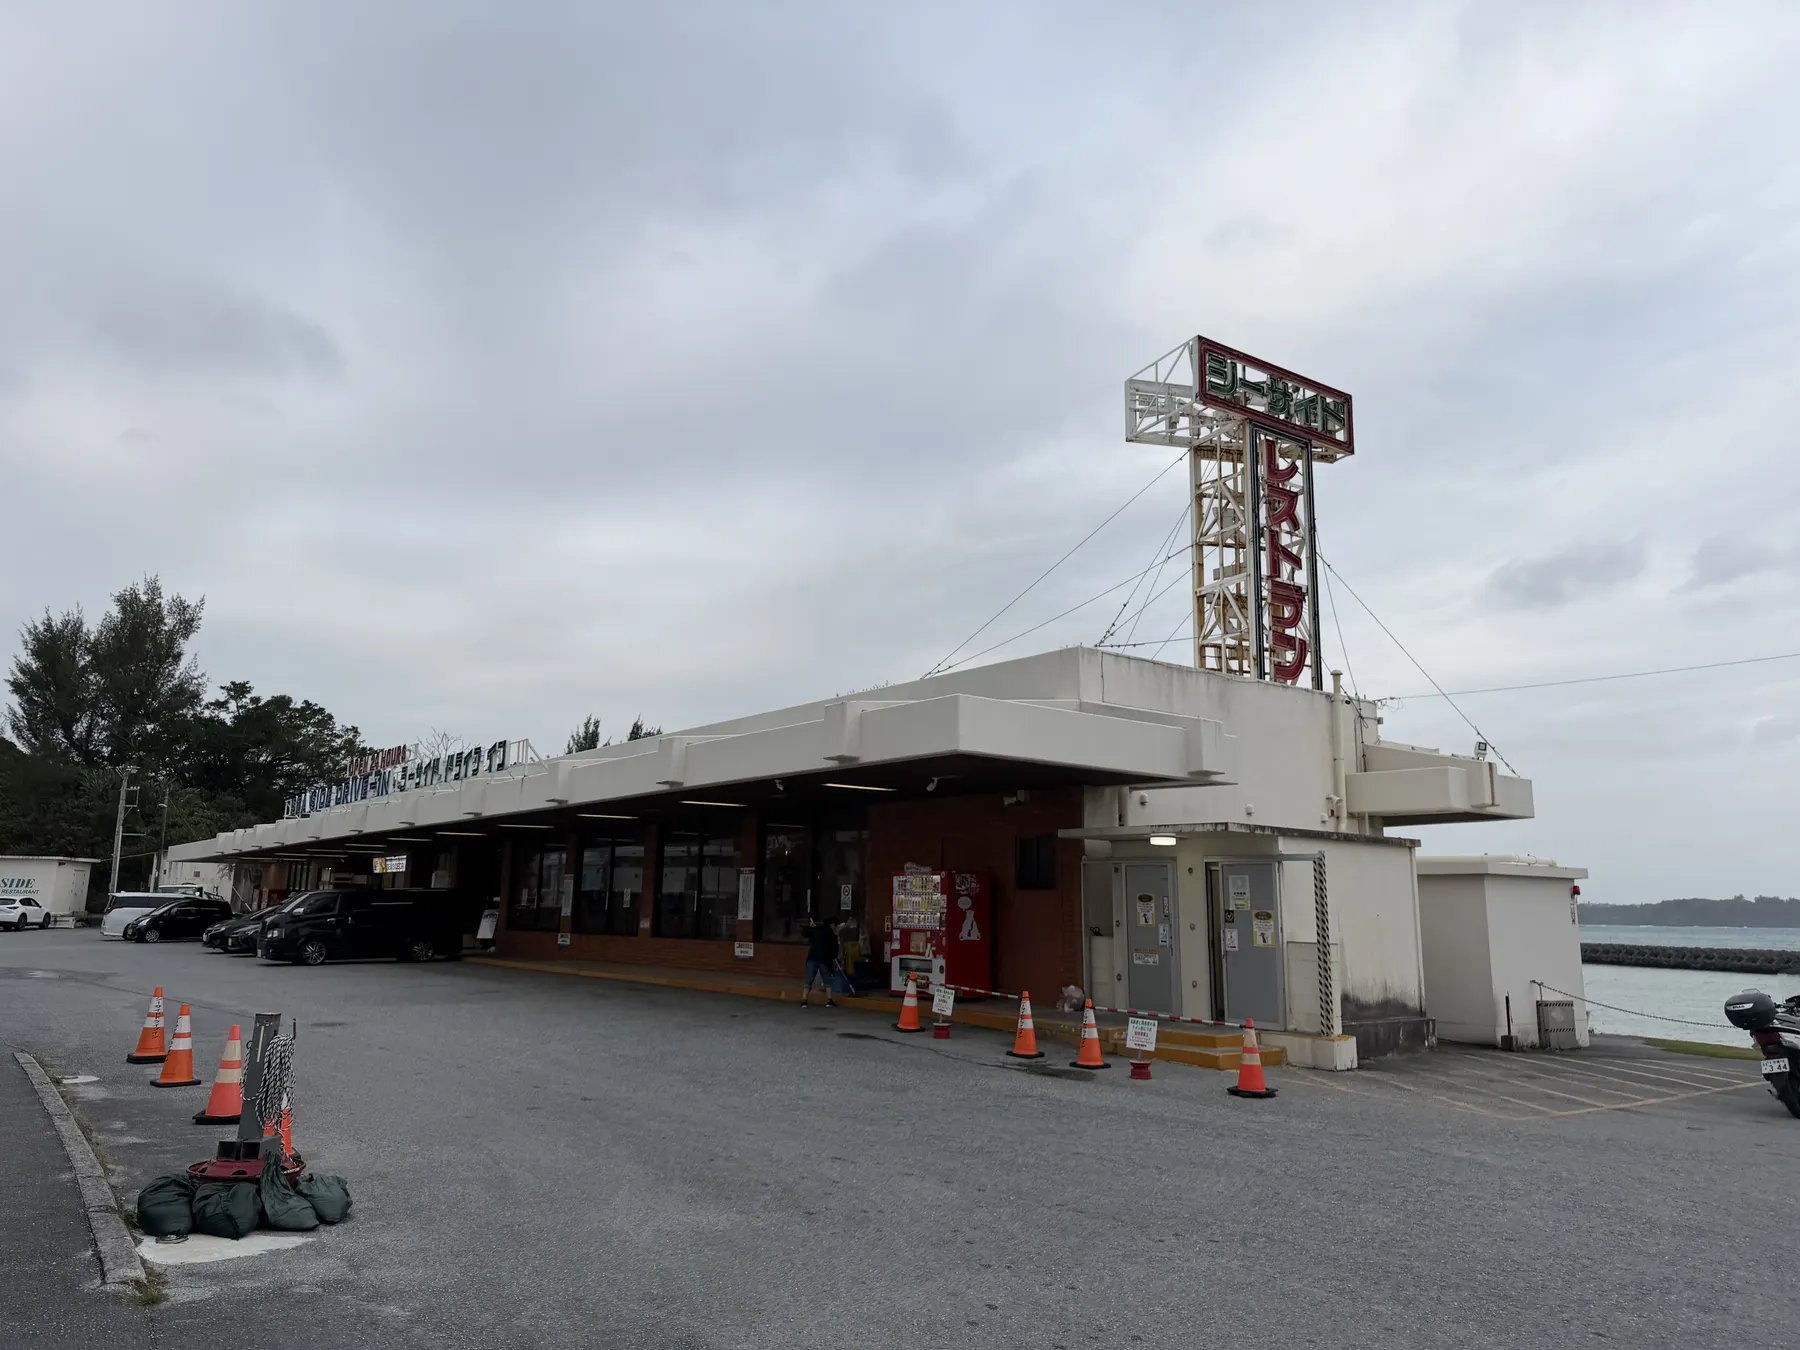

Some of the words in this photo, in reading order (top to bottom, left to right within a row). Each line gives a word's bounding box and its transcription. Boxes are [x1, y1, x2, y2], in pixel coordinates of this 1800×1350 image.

[1207, 352, 1345, 432] シーサイド
[1265, 438, 1307, 682] レストラン
[348, 755, 369, 777] OPEN
[370, 753, 380, 771] 24
[380, 744, 407, 770] HOURS
[290, 793, 306, 815] SEA
[310, 785, 332, 812] SIDE
[336, 770, 391, 806] DRIVE-IN
